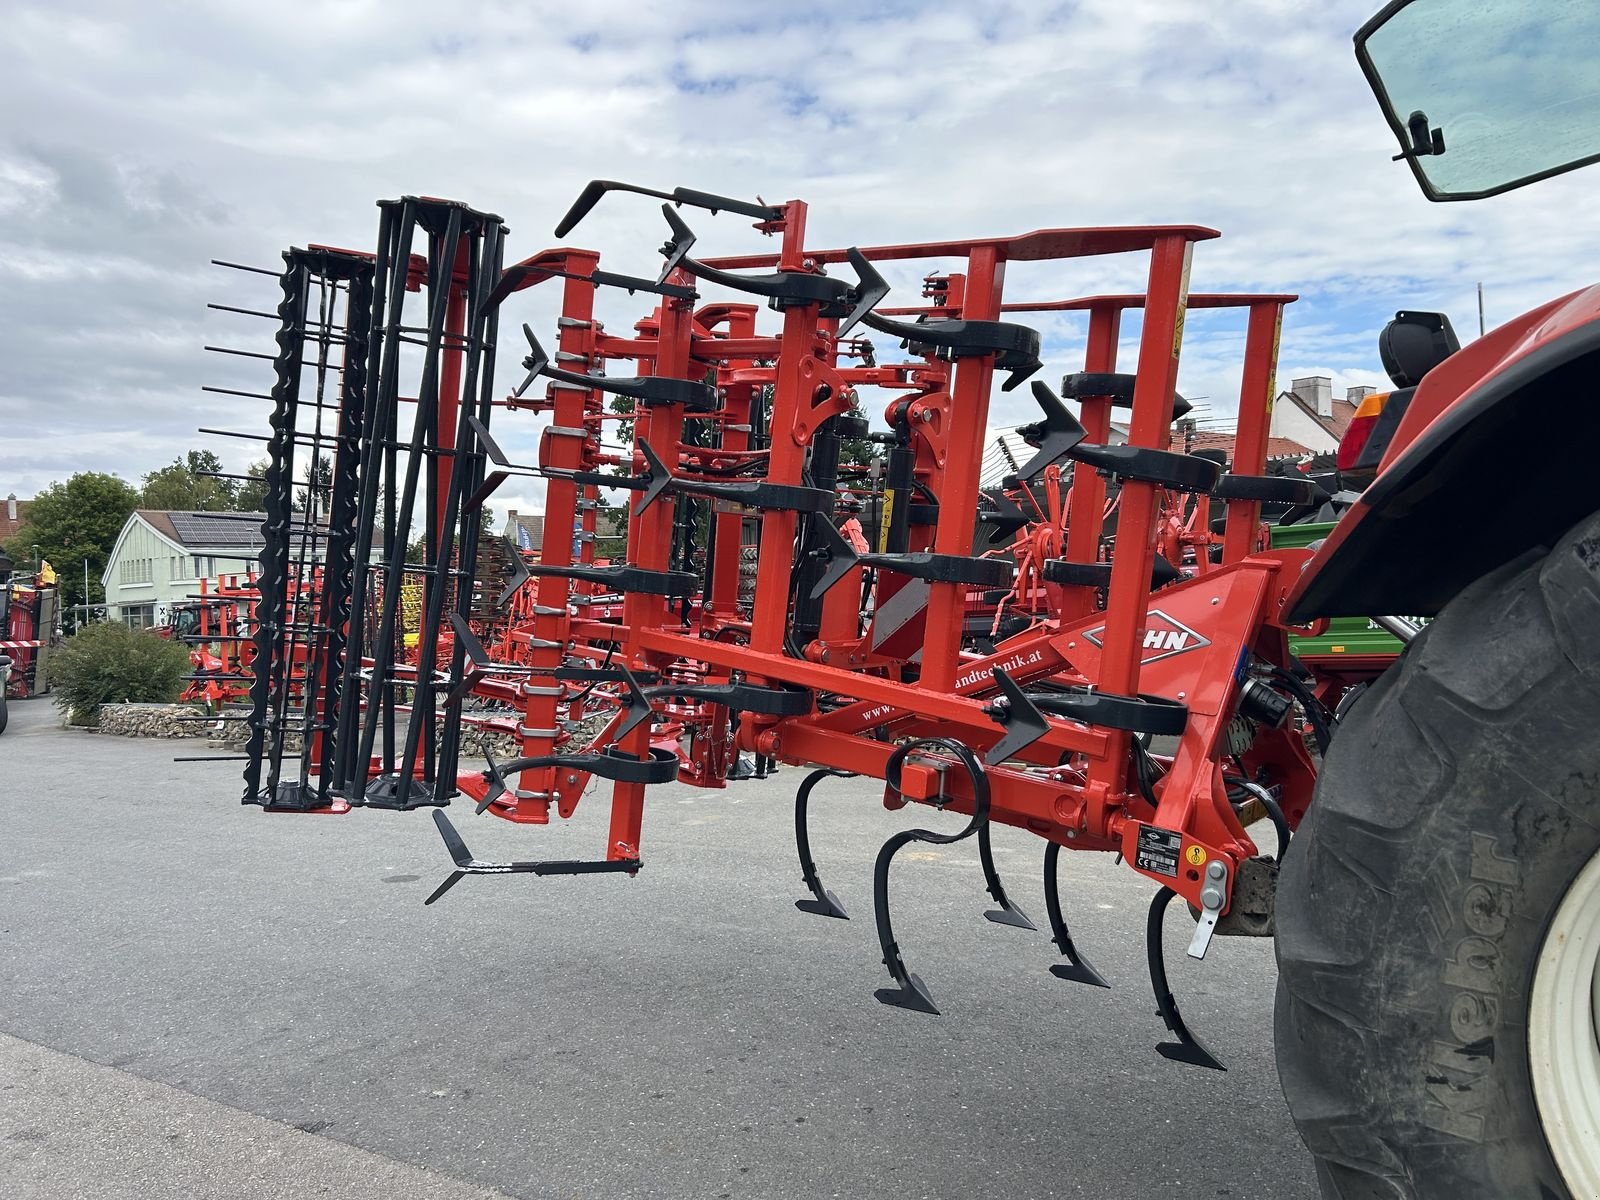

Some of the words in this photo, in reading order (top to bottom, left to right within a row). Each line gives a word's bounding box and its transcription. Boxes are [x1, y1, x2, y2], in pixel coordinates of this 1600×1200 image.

[1143, 631, 1188, 650] HN
[955, 649, 1043, 689] andtecnik.at
[1424, 831, 1519, 1143] Kleber
